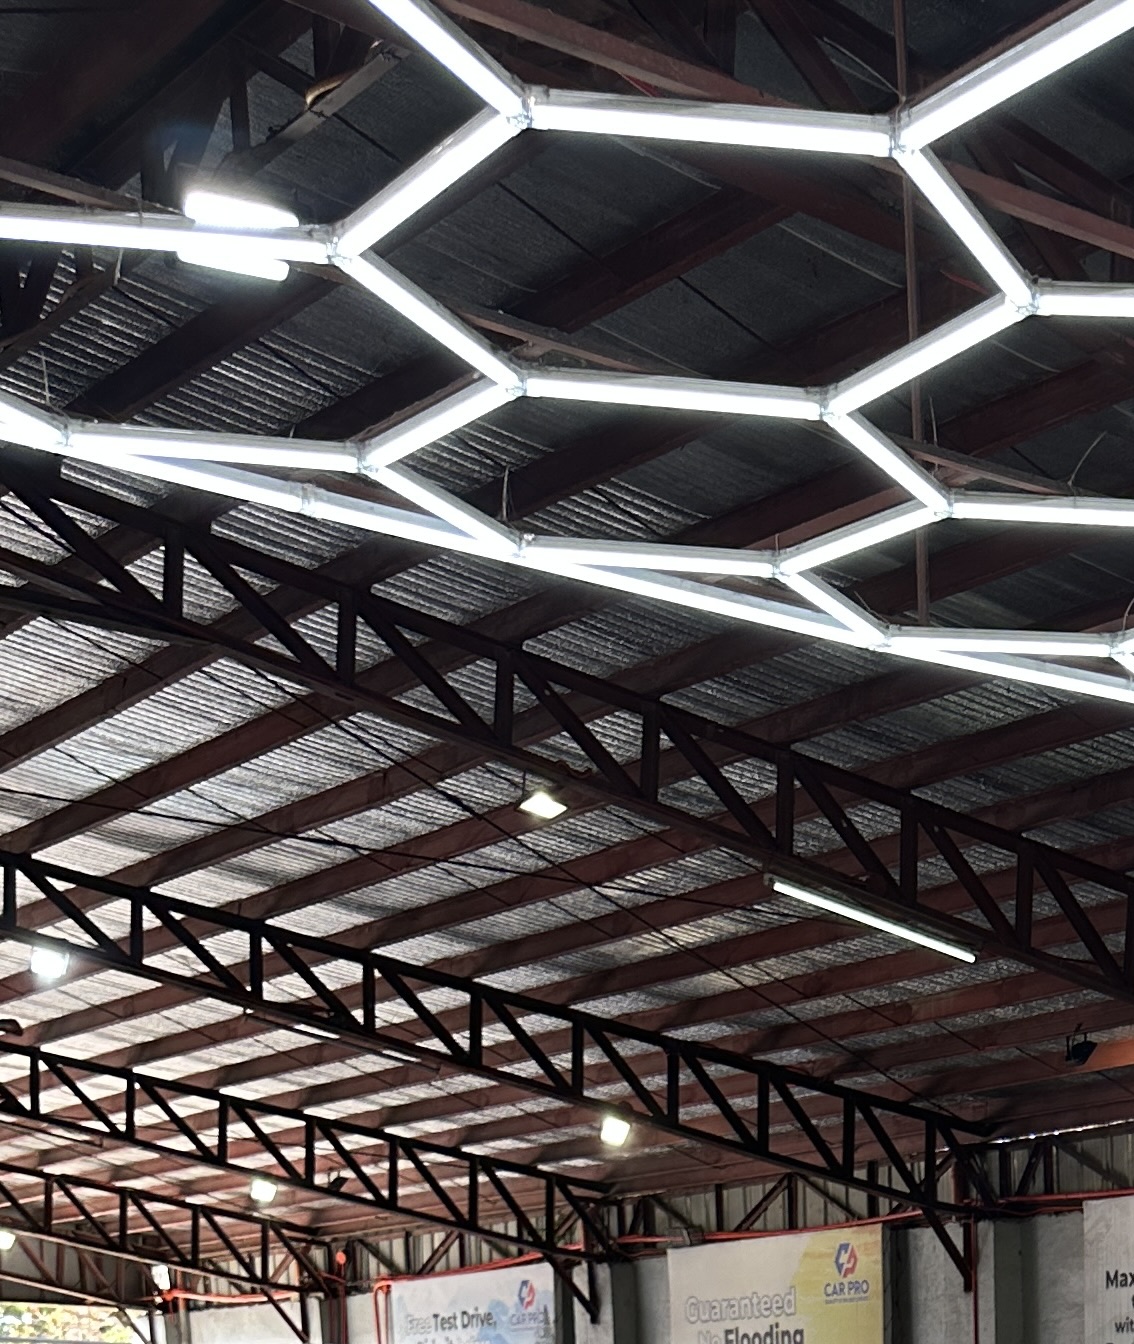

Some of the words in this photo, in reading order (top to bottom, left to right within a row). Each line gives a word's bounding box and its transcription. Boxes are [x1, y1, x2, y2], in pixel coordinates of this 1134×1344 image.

[823, 1282, 845, 1297] CAR
[847, 1279, 870, 1295] PRO
[685, 1285, 797, 1325] Guaranteed
[432, 1311, 458, 1331] Test
[461, 1306, 497, 1328] Drive,
